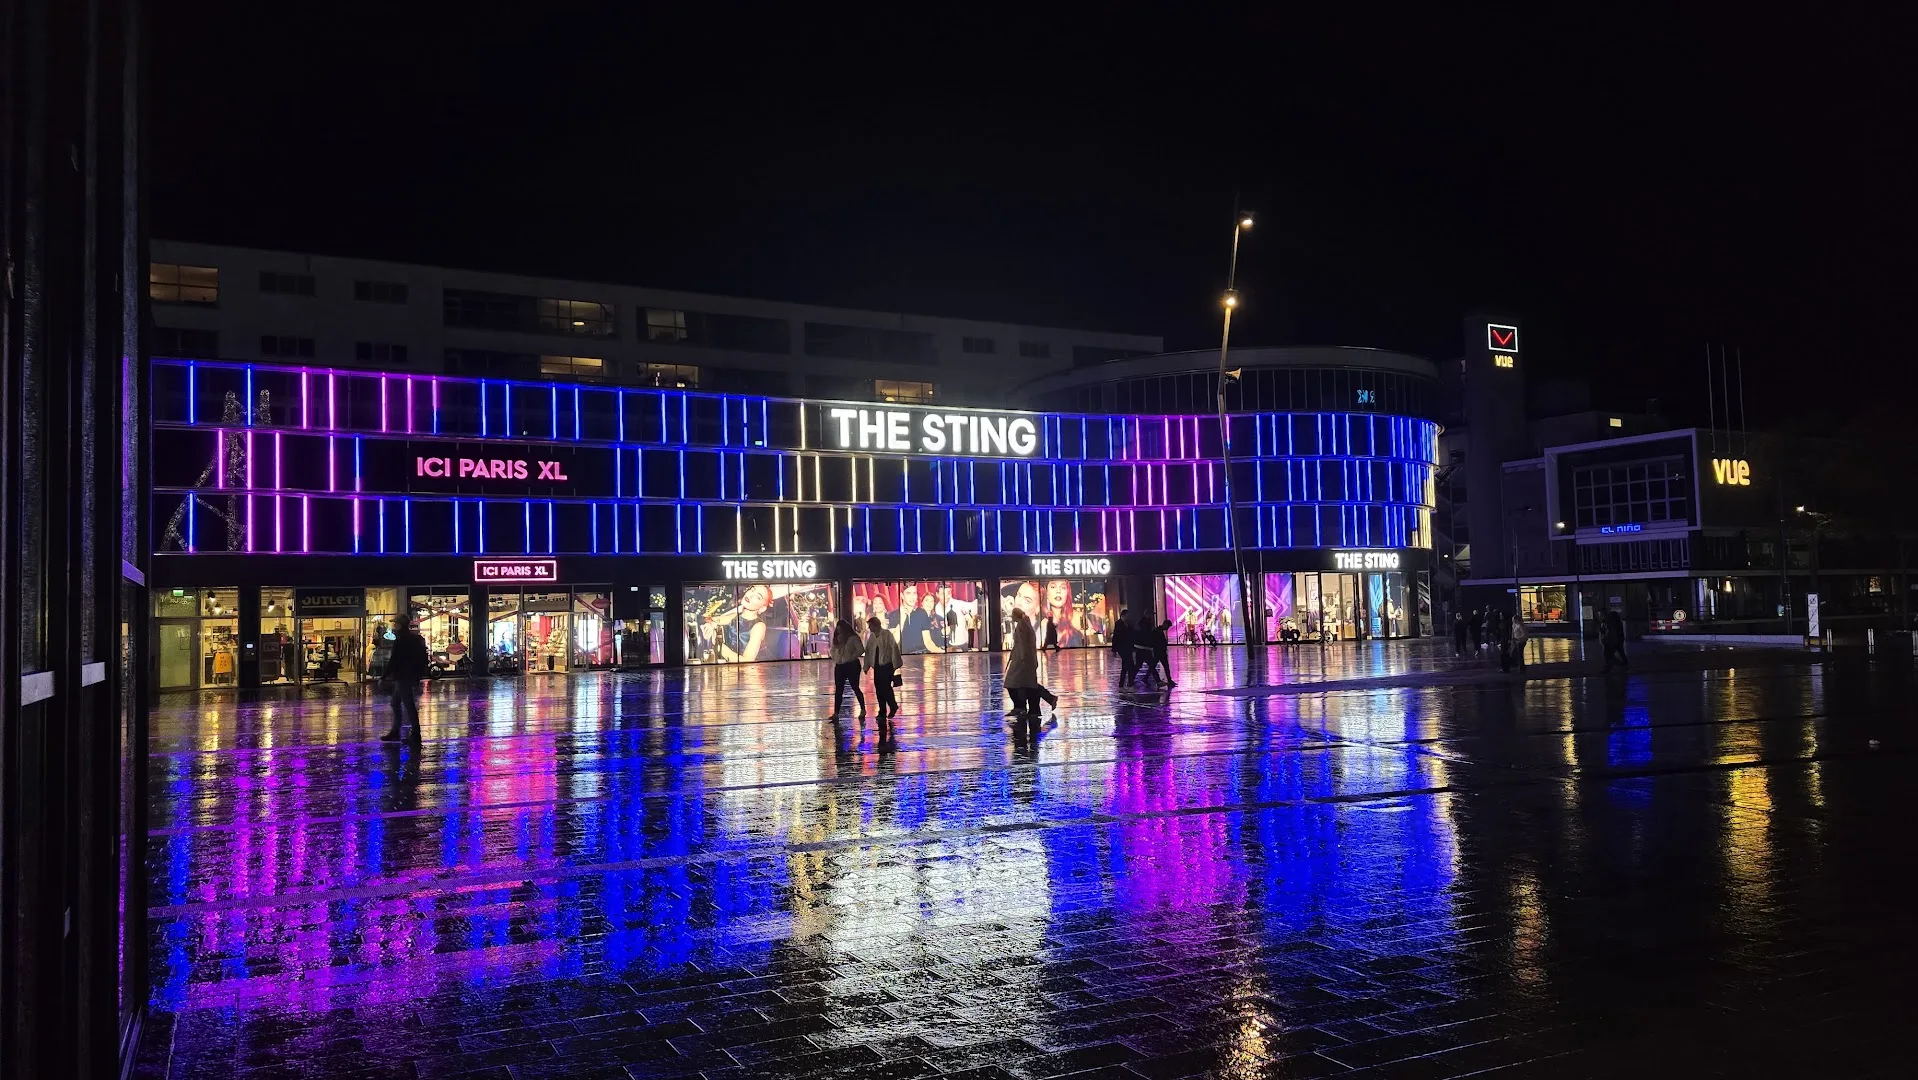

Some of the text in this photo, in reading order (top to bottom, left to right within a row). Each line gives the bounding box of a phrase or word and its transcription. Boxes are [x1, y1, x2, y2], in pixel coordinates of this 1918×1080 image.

[831, 408, 1036, 455] THE STING
[416, 456, 568, 481] ICI PARIS XL
[1601, 526, 1615, 534] EL
[721, 560, 817, 579] THE STING
[1031, 558, 1111, 576] THE STING
[1334, 552, 1399, 569] THE STING
[482, 565, 549, 576] ICI PARIS XL
